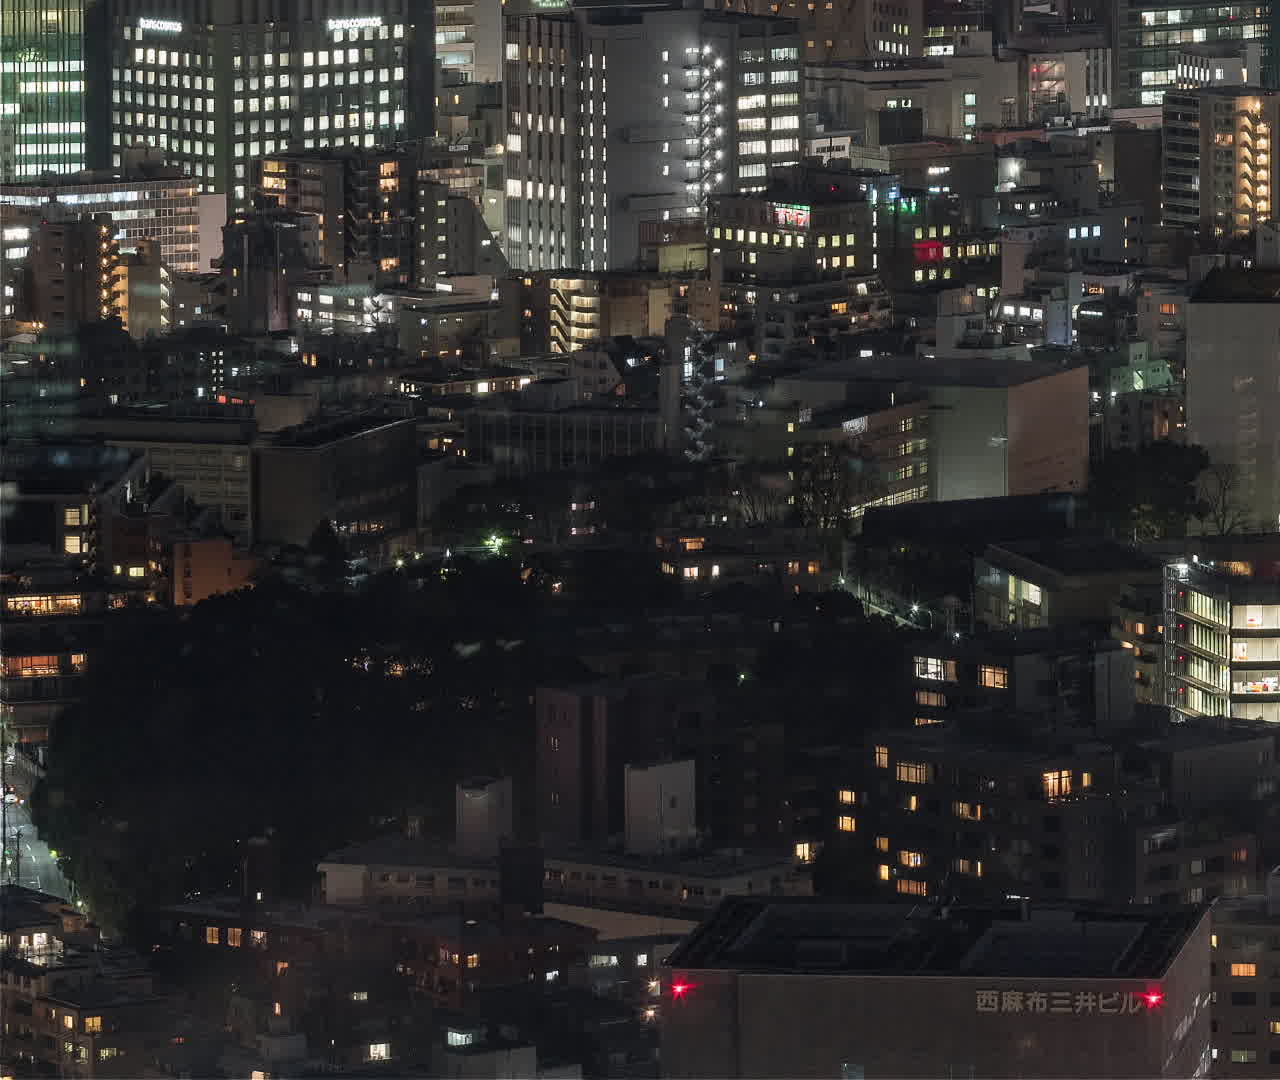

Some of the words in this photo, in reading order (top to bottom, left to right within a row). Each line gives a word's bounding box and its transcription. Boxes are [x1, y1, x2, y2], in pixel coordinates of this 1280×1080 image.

[975, 990, 1141, 1014] 西麻布三井ビル
